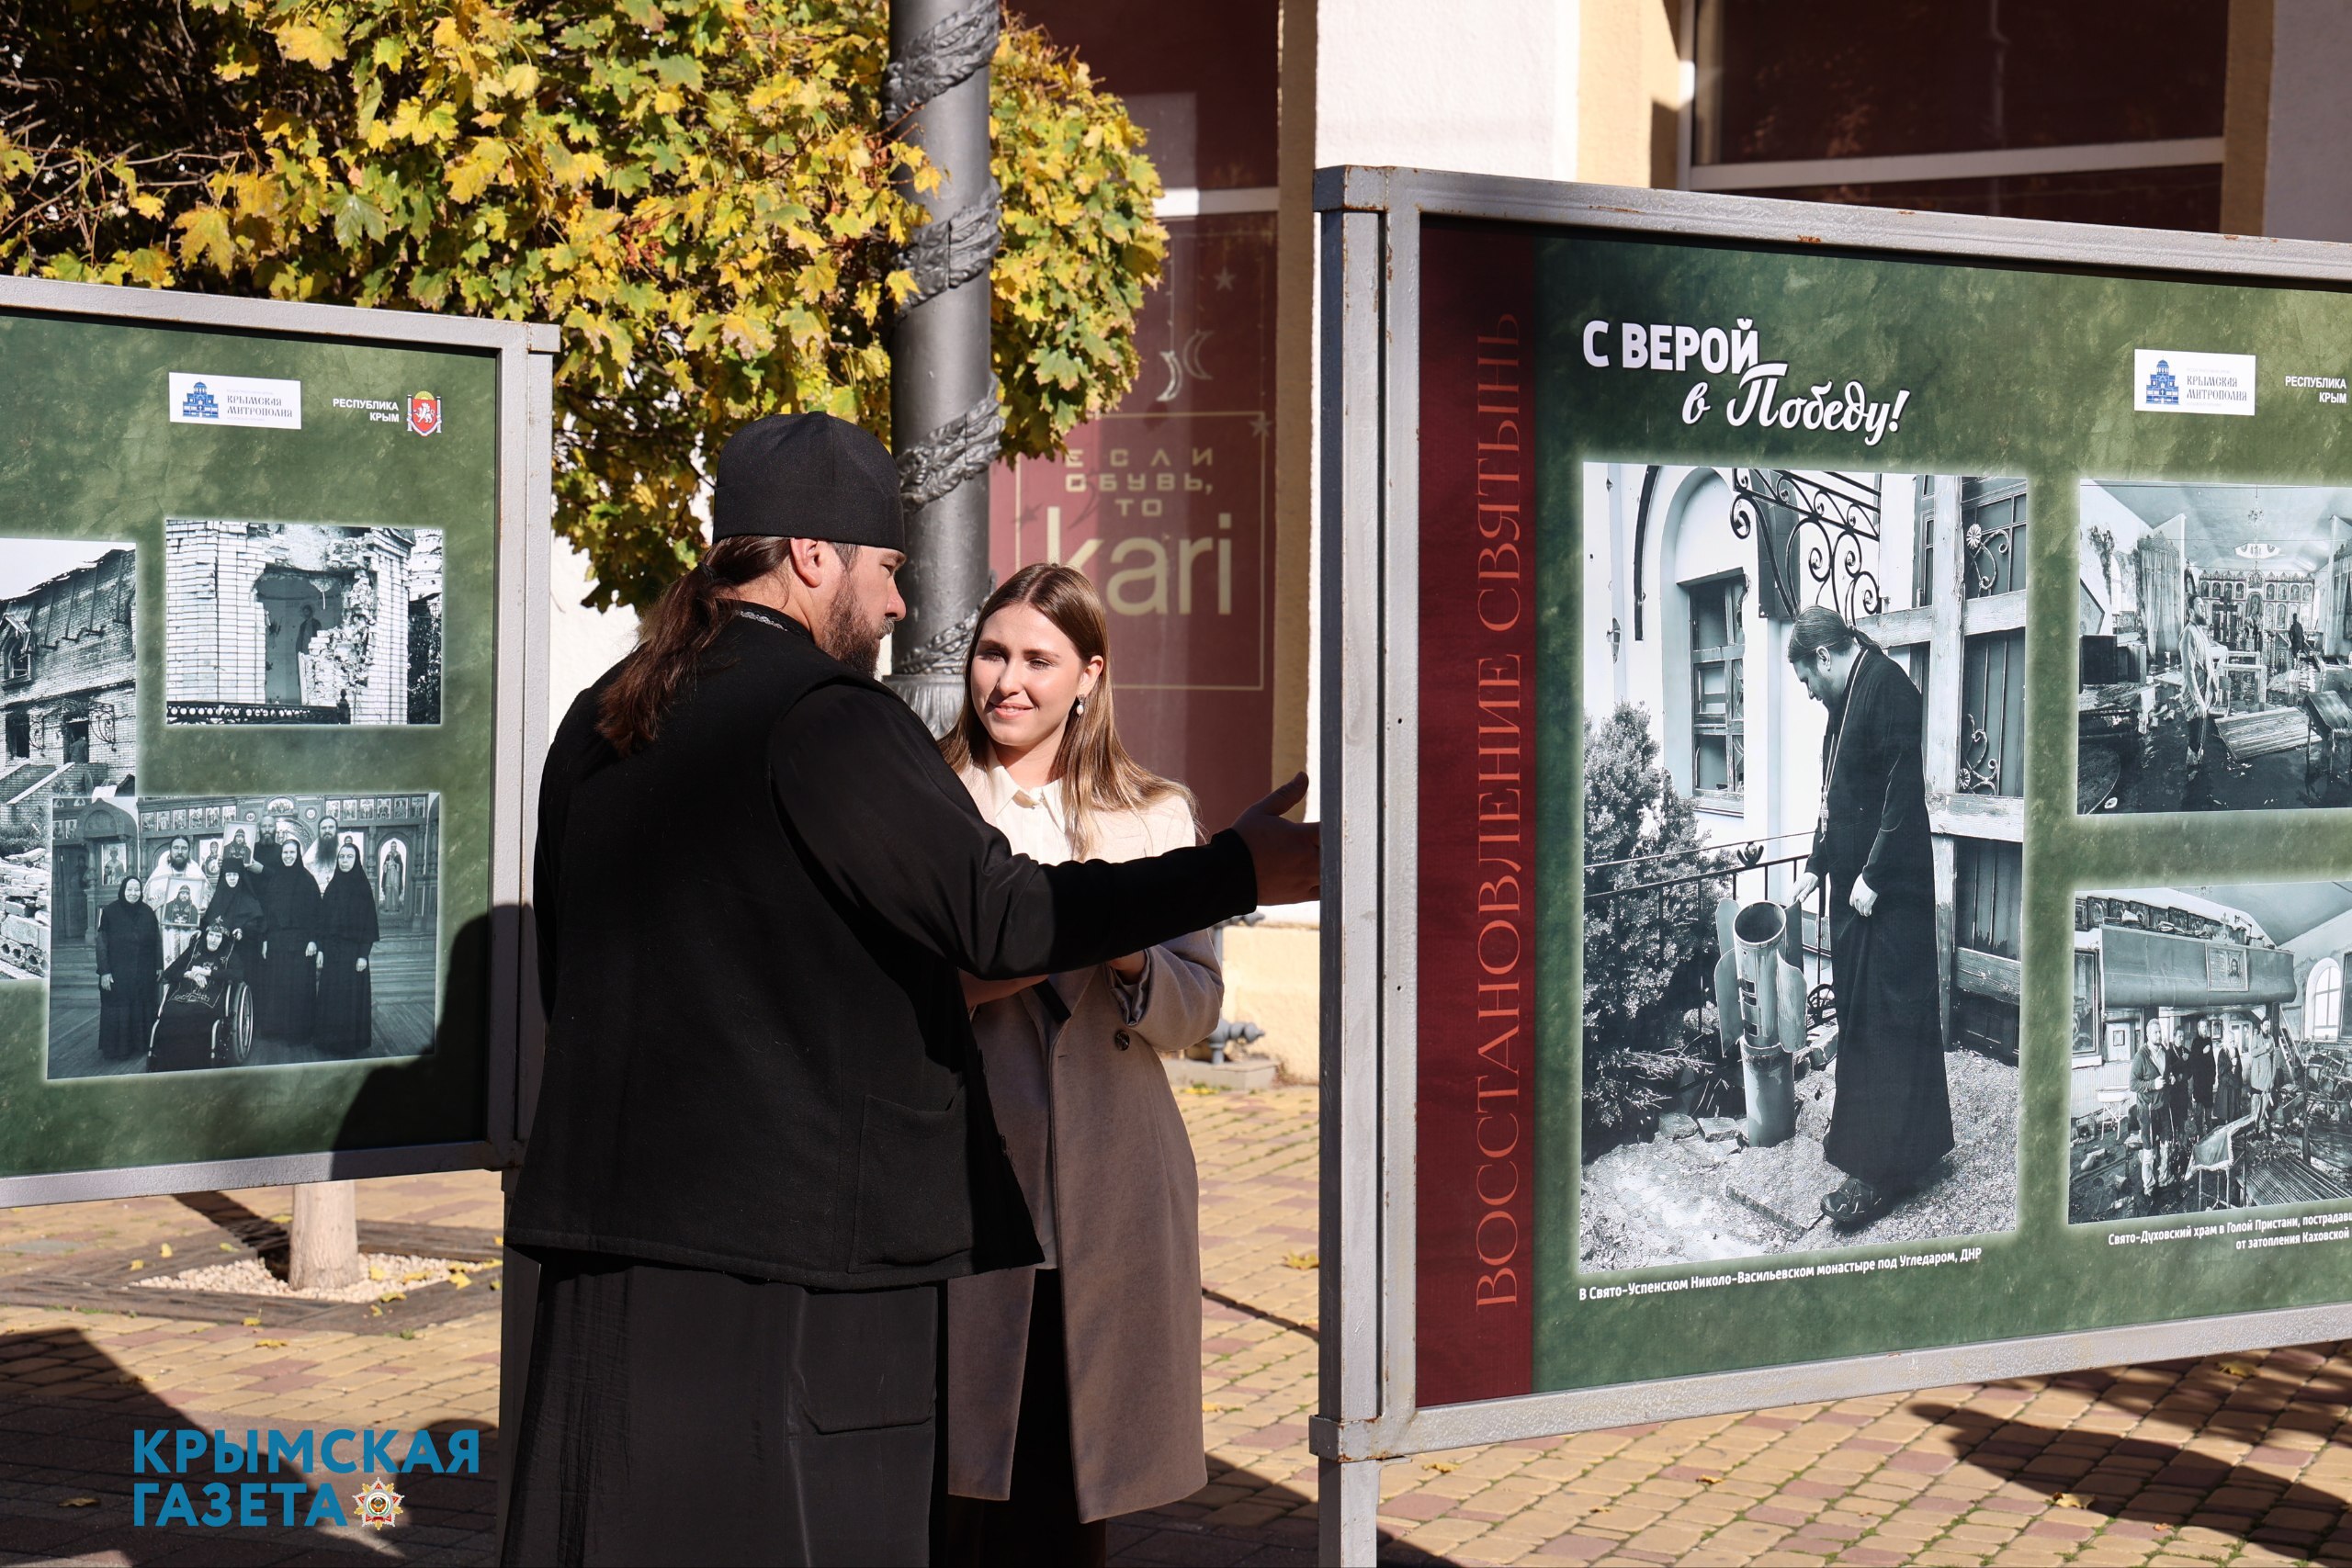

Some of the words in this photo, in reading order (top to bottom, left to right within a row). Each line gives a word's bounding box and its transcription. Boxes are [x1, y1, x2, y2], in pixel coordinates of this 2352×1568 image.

[1583, 320, 1610, 368] С
[1622, 318, 1758, 375] ВЕРОЙ
[2187, 375, 2238, 388] КРЫМСКАЯ
[2285, 376, 2347, 389] РЕСПУБЛИКА
[226, 395, 283, 407] КРЫМСКАЯ
[1681, 381, 1712, 425] в
[1725, 362, 1911, 446] Победу!
[2186, 389, 2247, 401] МИТРОПОЛИЯ
[2319, 391, 2347, 404] КРЫМ
[226, 405, 293, 418] МИТРОПОЛИЯ
[333, 398, 400, 412] РЕСПУБЛИКА
[369, 412, 400, 423] КРЫМ
[1065, 448, 1213, 468] ЕСЛИ
[1475, 312, 1521, 632] СВЯТЫНЬ
[1065, 473, 1213, 494] ОБУВЬ,
[1115, 499, 1163, 516] ТО
[1476, 653, 1521, 1313] ВОССТАНОВЛЕНИЕ
[2109, 1225, 2192, 1246] Свято-Духовский
[2193, 1224, 2218, 1237] храм
[2220, 1224, 2224, 1233] в
[2227, 1219, 2253, 1233] Голой
[2256, 1216, 2301, 1230] Пристани,
[2236, 1240, 2245, 1250] от
[2248, 1235, 2300, 1248] затопления
[2302, 1226, 2350, 1243] Каховской
[1578, 1288, 1587, 1301] В
[1589, 1279, 1689, 1300] Свято-Успенском
[1690, 1267, 1815, 1289] Николо-Васильевском
[1816, 1259, 1875, 1275] монастыре
[1877, 1258, 1898, 1270] под
[1899, 1250, 1959, 1267] Угледаром,
[1960, 1247, 1983, 1261] ДНР
